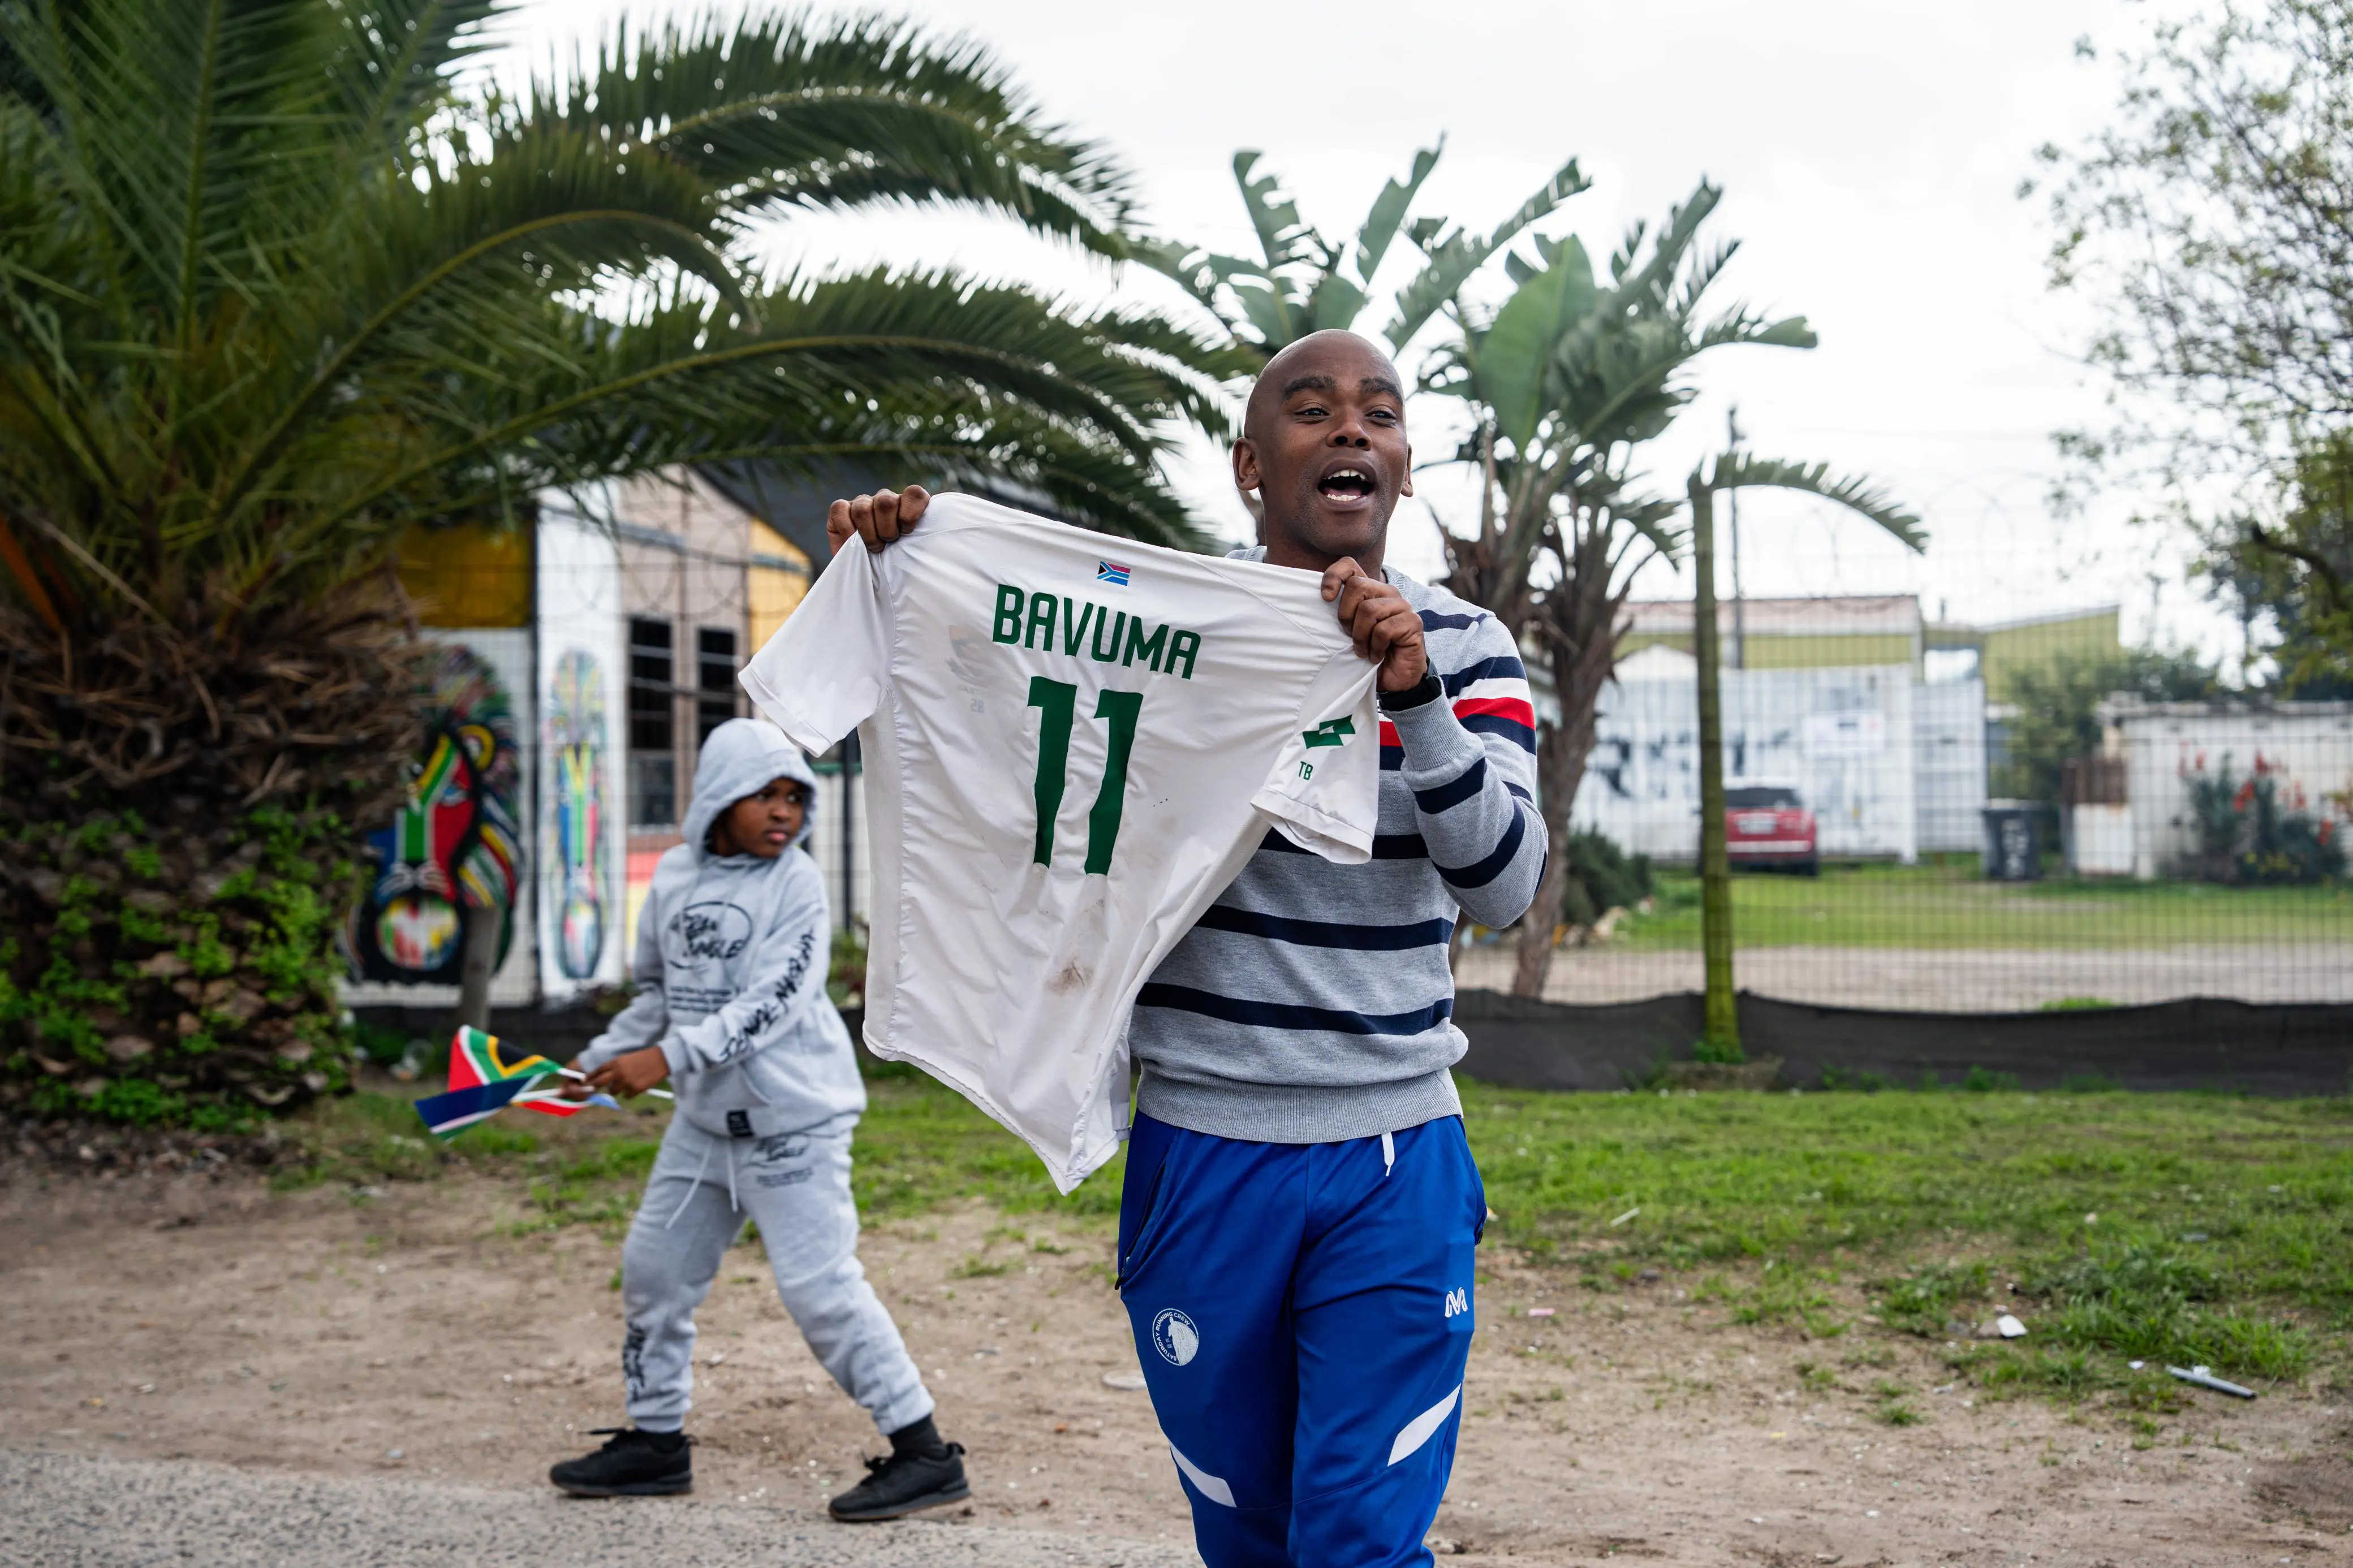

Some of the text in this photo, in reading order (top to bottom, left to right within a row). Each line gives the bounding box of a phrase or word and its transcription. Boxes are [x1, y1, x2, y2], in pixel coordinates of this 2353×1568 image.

[992, 584, 1201, 680] BAVUMA
[1027, 676, 1143, 876] 11
[1299, 761, 1313, 781] TB
[1156, 1311, 1173, 1331] RUNNING
[1174, 1312, 1190, 1325] CREW
[1156, 1332, 1176, 1361] SATURDAY
